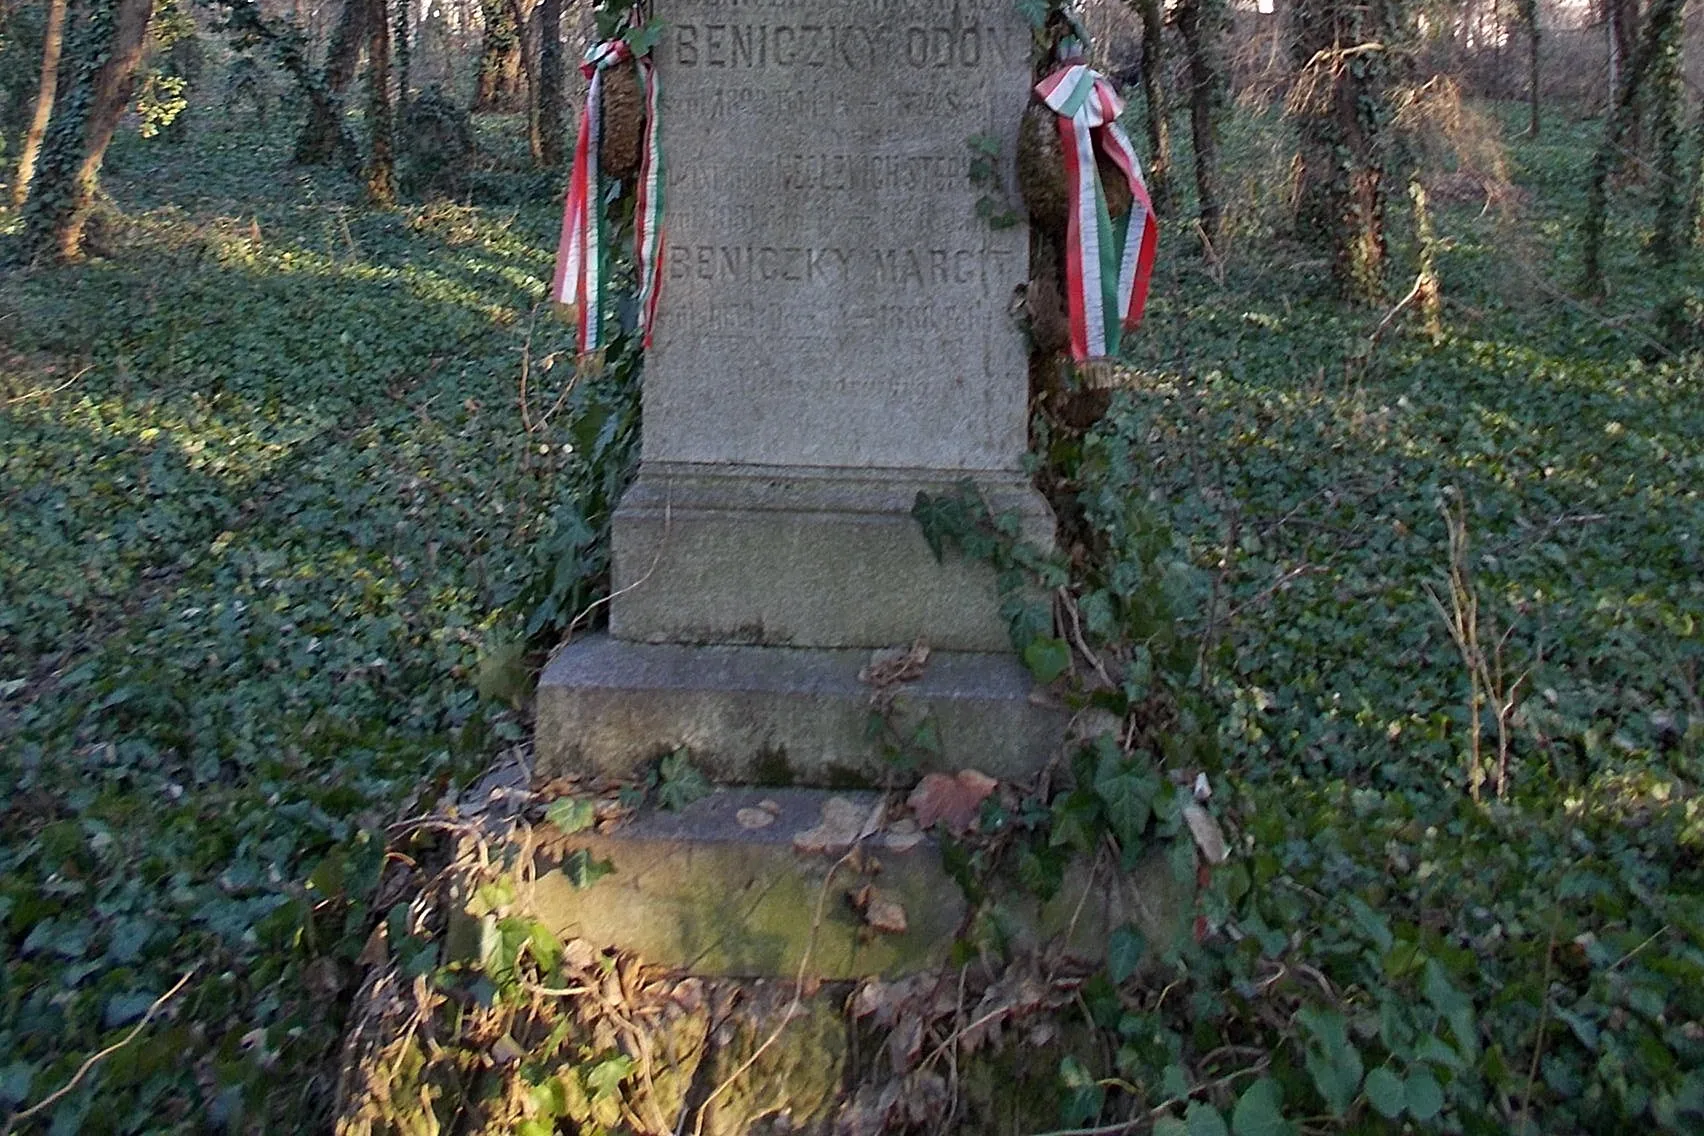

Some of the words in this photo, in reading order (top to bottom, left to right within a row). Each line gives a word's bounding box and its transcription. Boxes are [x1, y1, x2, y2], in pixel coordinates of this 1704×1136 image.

[675, 23, 884, 69] BENICZKY
[671, 246, 858, 284] BENICZKY
[871, 247, 1012, 290] MARGIT
